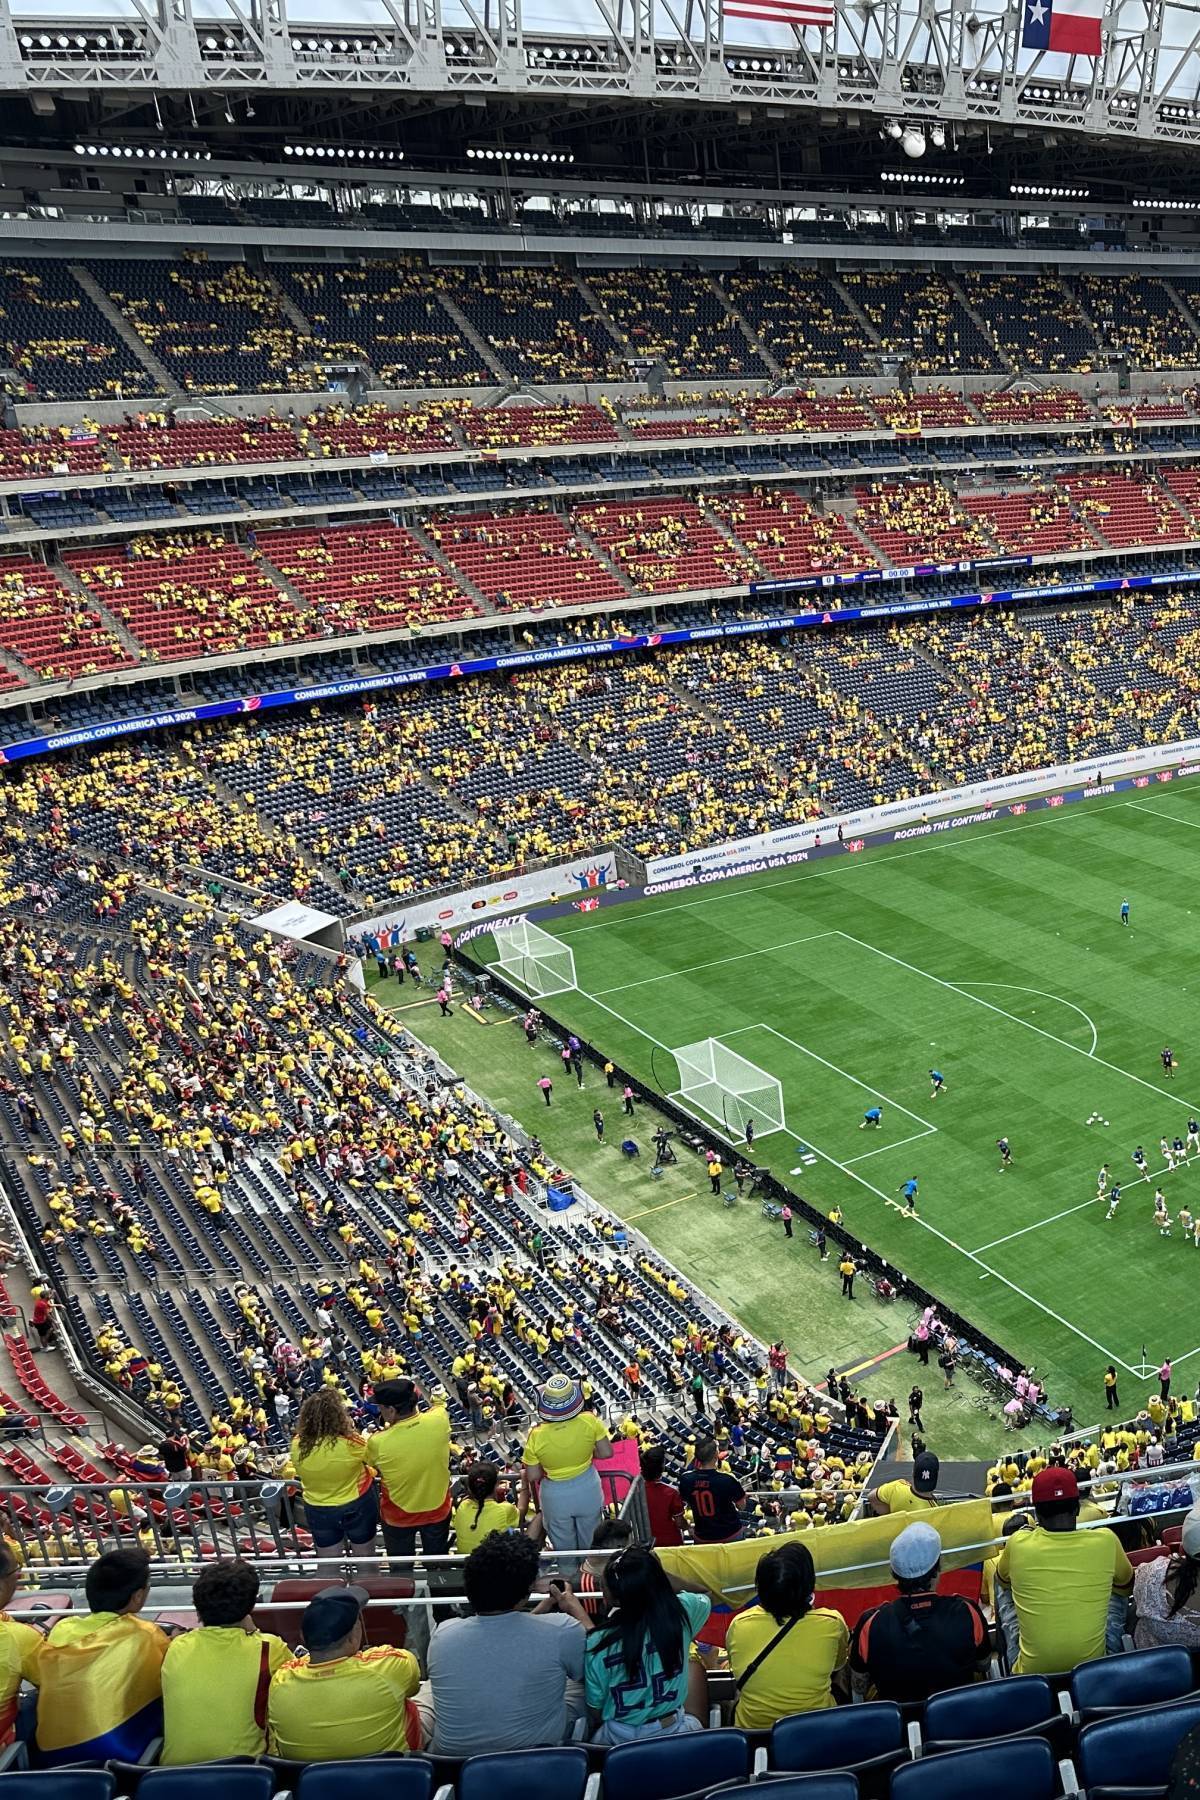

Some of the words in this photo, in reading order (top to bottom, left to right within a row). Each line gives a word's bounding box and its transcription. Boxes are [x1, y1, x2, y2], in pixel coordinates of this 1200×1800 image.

[294, 686, 338, 700] CONMEBOL
[338, 683, 360, 693] COPA
[360, 677, 394, 690] AMERICA
[48, 732, 95, 748] CONMEBOL
[95, 726, 118, 738] COPA
[116, 718, 156, 734] AMERICA
[1083, 784, 1115, 798] HOUSTON
[894, 824, 932, 840] ROCKING
[932, 820, 950, 832] THE
[952, 810, 1000, 828] CONTINENT
[644, 874, 700, 896] CONMEBOL
[699, 870, 726, 884] COPA
[725, 862, 767, 878] AMERICA
[768, 858, 786, 868] USA
[786, 852, 808, 864] 2024
[652, 861, 685, 875] CONMEBOL
[684, 858, 702, 868] COPA
[700, 853, 726, 864] AMERICA
[460, 913, 530, 944] CONTINENTE
[691, 1490, 716, 1516] 10
